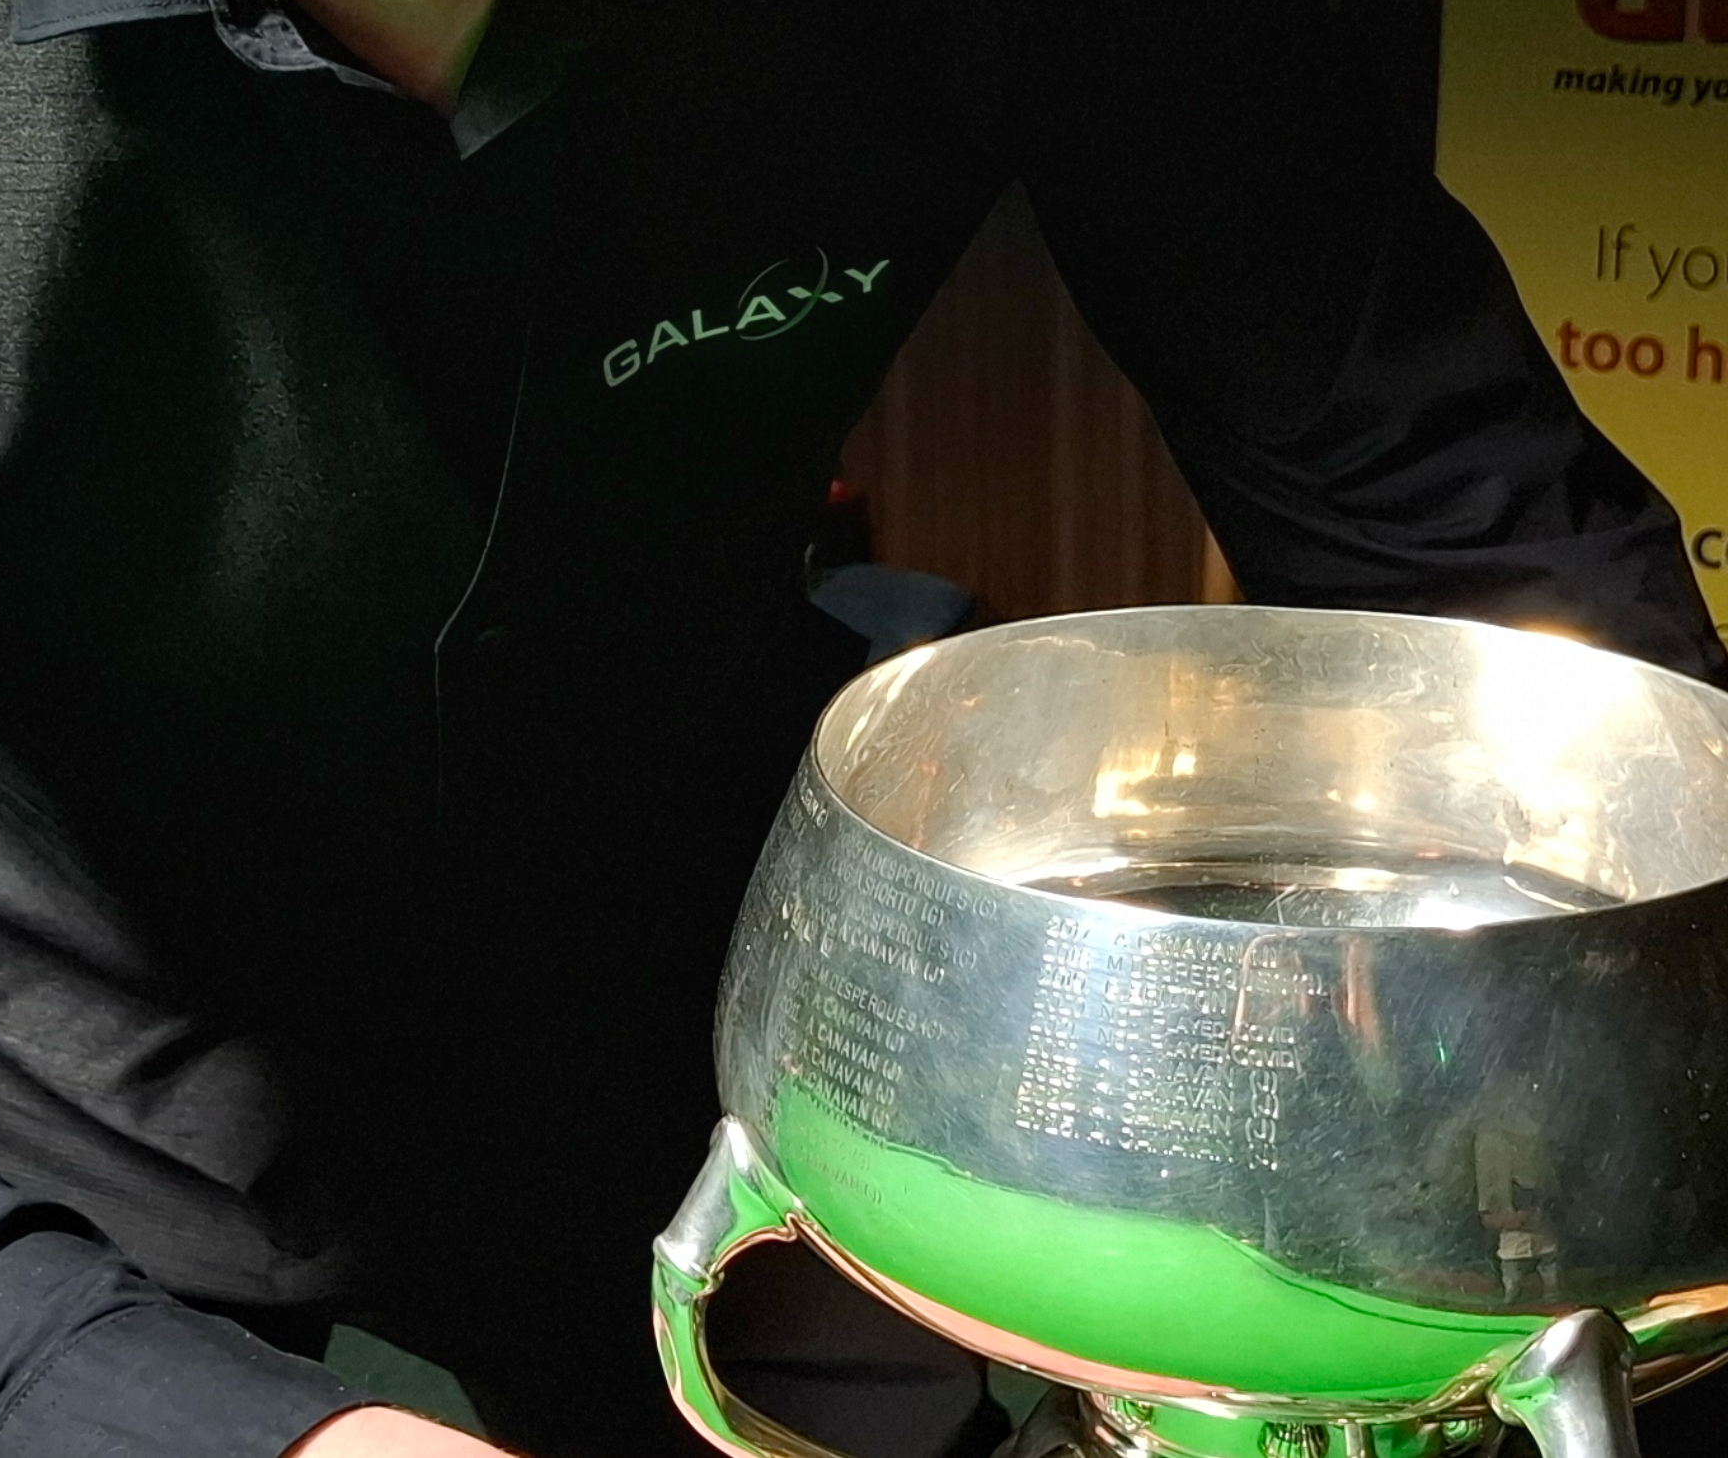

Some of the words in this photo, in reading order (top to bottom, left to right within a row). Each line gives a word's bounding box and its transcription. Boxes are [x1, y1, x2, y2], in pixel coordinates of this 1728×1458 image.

[1554, 63, 1685, 106] making
[1594, 222, 1638, 282] If
[603, 259, 891, 388] GALAXY
[1557, 318, 1664, 379] too
